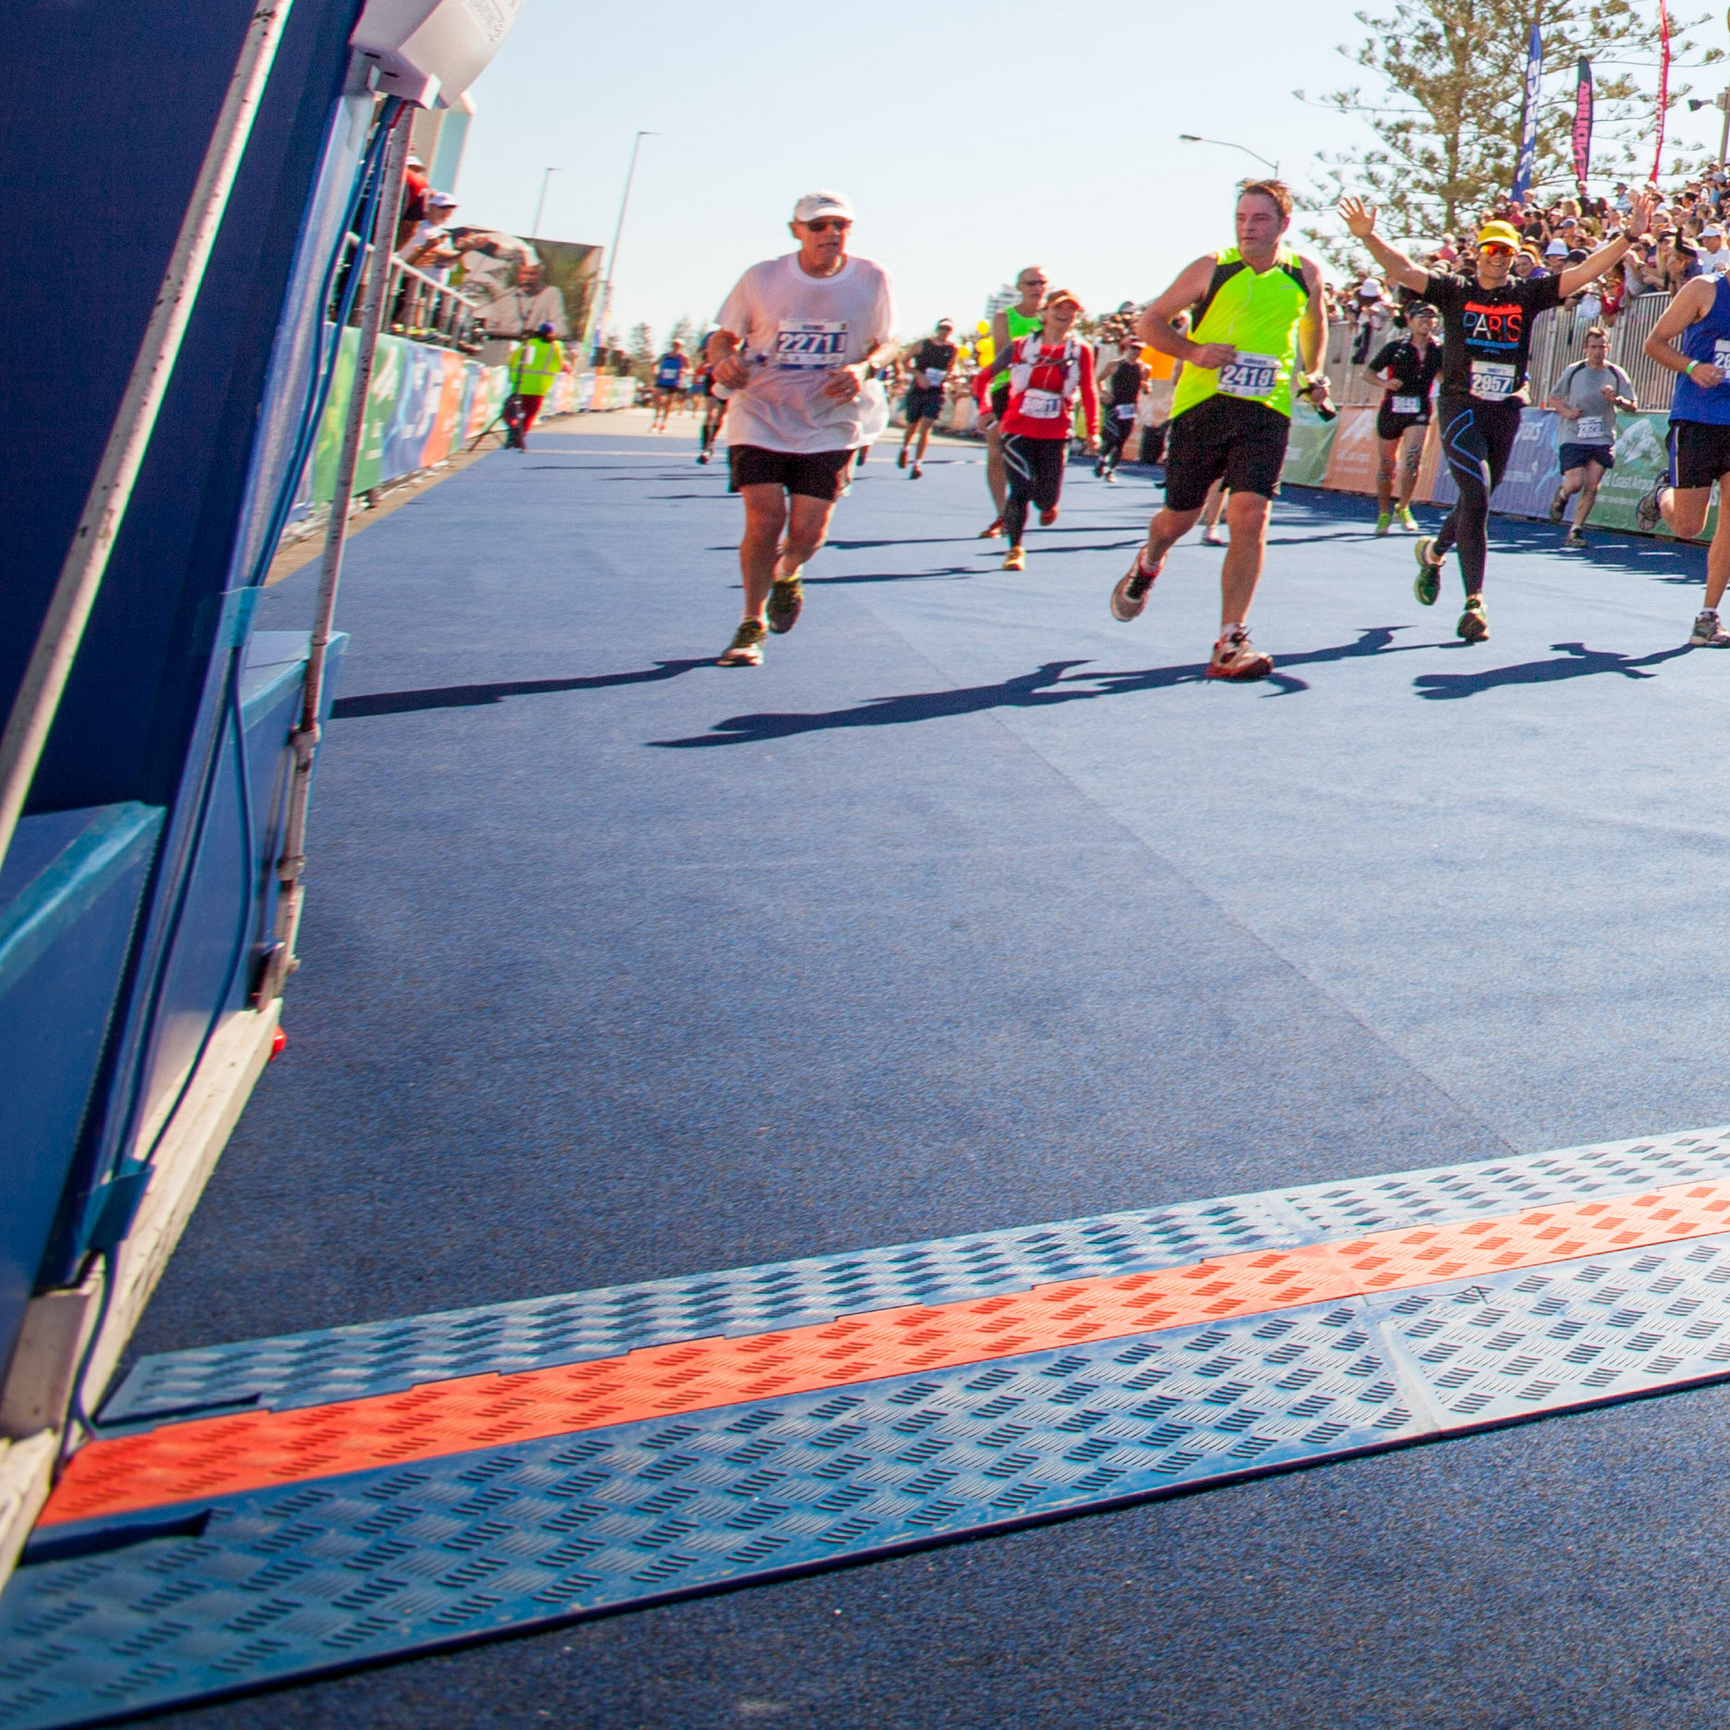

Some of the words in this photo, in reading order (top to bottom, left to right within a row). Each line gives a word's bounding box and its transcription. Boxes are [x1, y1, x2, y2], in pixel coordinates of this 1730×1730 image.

[1463, 311, 1523, 342] PARIS
[779, 333, 834, 353] 2271
[1221, 364, 1273, 386] 2419
